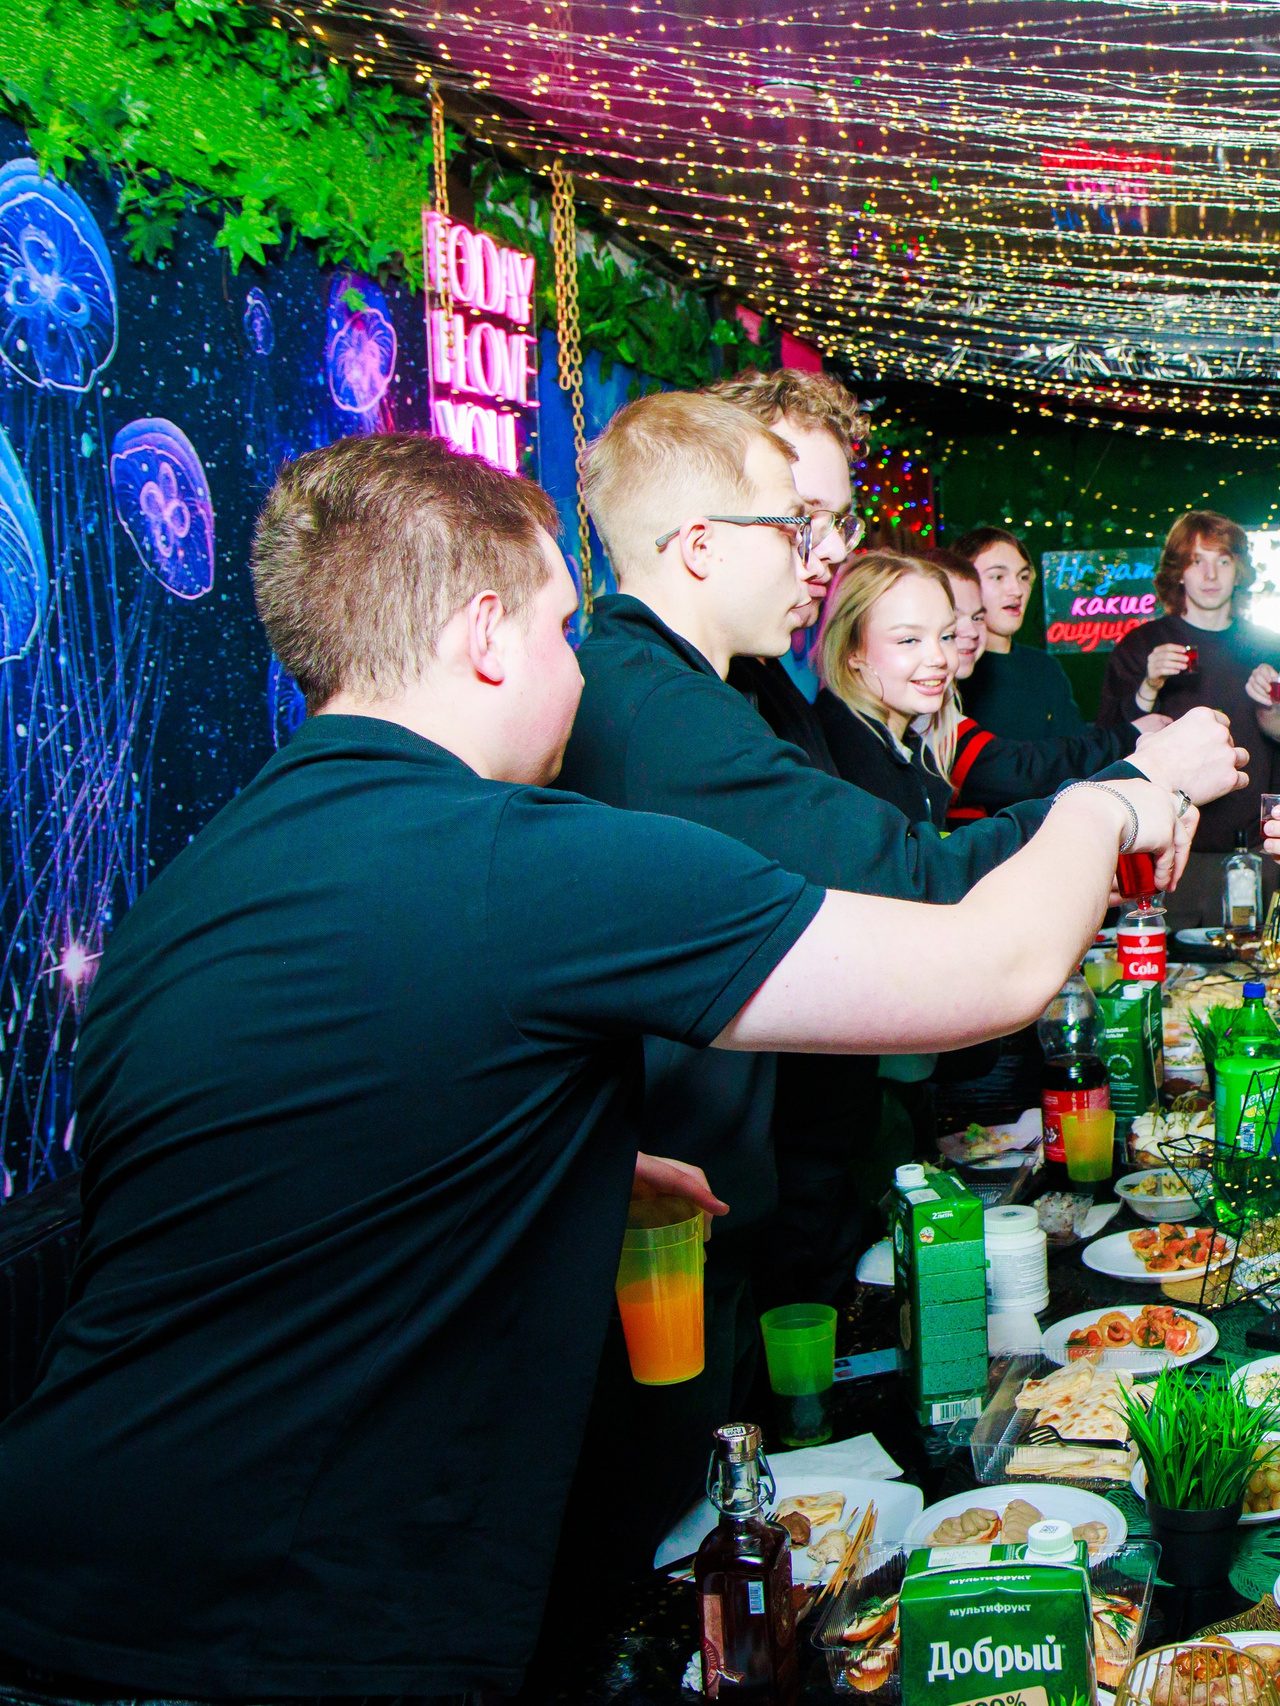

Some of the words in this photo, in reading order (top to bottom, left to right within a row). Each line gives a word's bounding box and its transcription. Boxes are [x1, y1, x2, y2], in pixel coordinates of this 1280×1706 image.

[423, 211, 535, 325] TODAY
[1071, 593, 1156, 617] какие
[1047, 617, 1155, 652] ощуще
[1129, 961, 1159, 975] Cola
[949, 1575, 1031, 1585] мультифрукт
[949, 1602, 1031, 1617] мультифрукт
[927, 1635, 1063, 1682] Добрый
